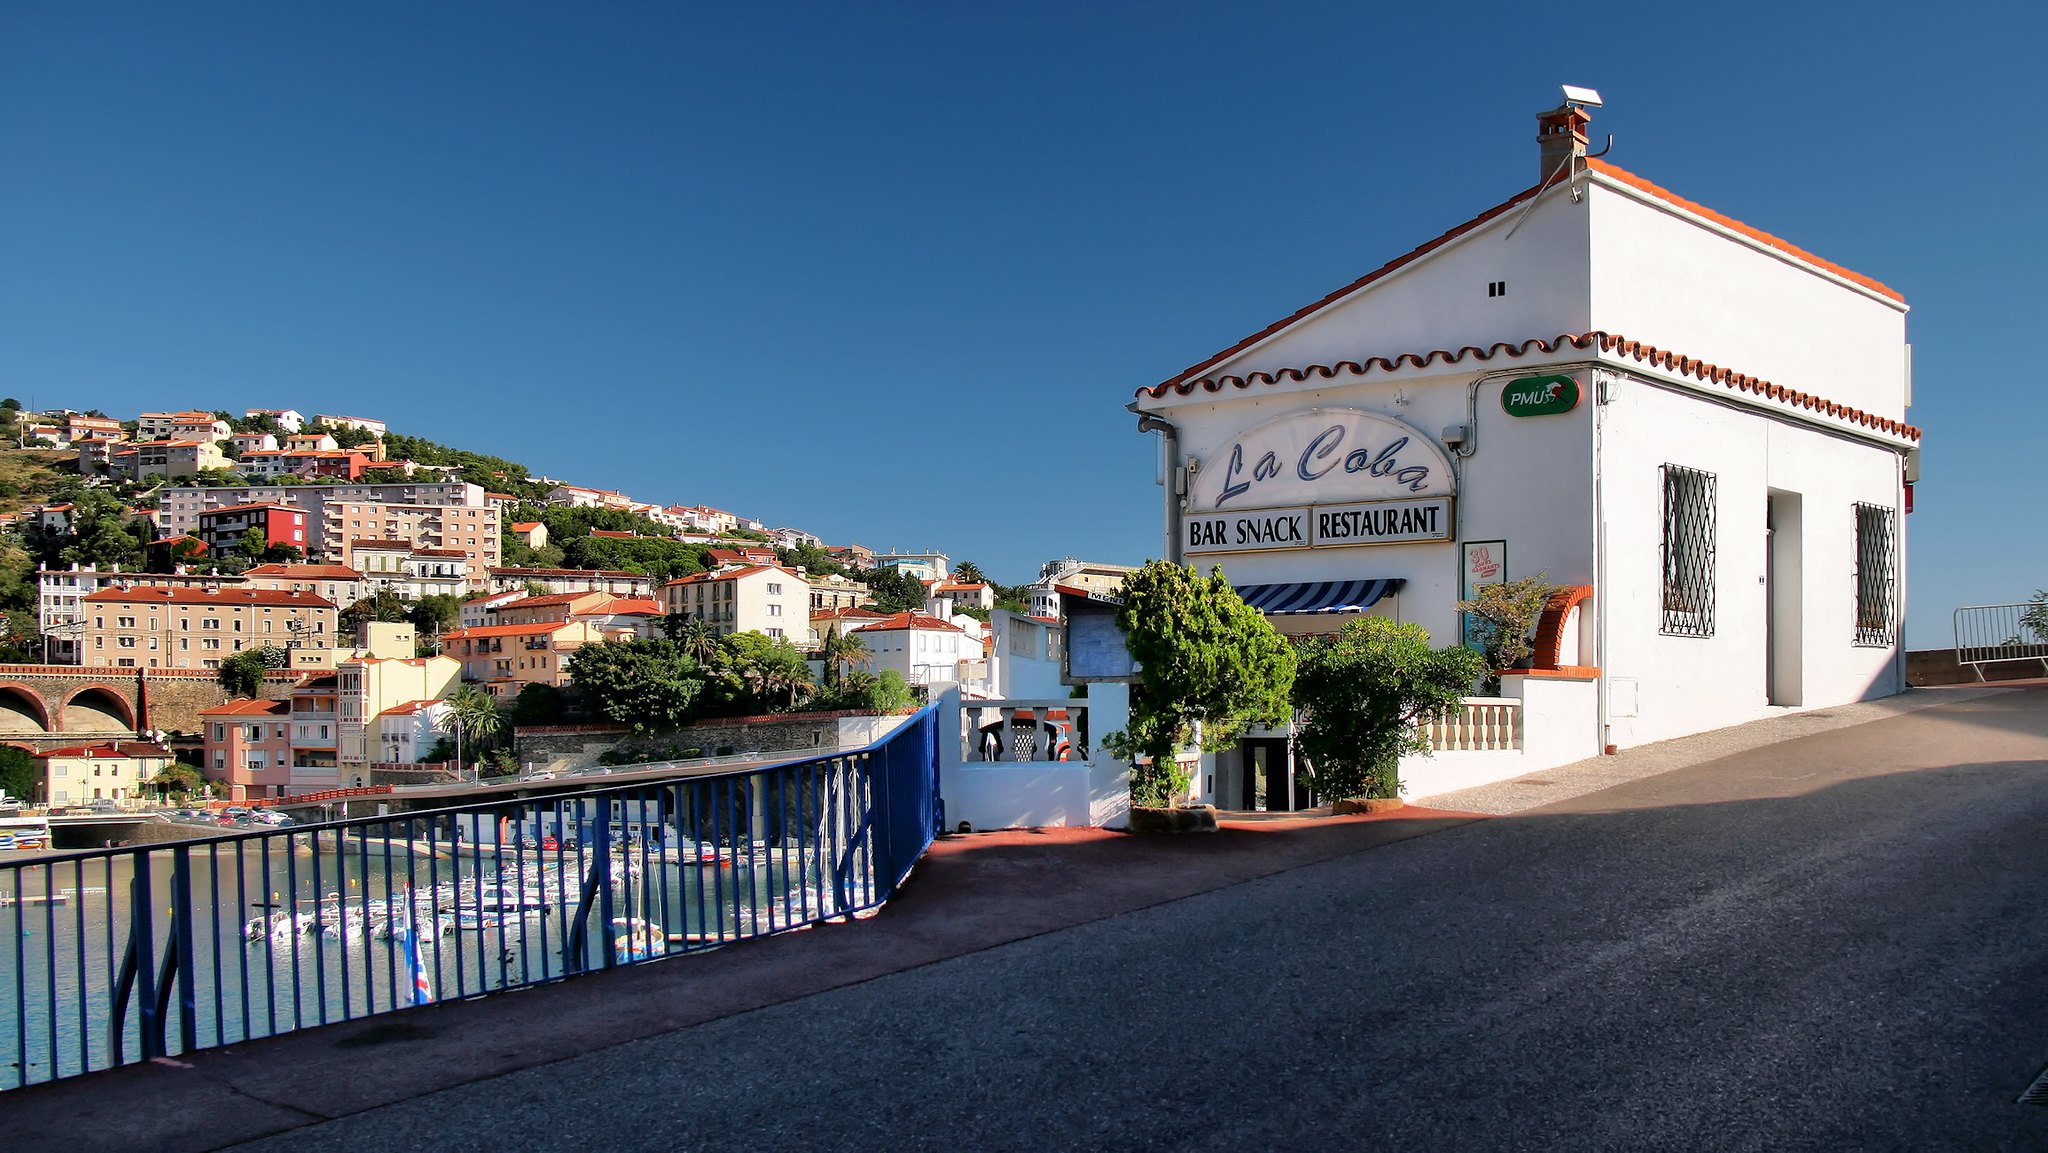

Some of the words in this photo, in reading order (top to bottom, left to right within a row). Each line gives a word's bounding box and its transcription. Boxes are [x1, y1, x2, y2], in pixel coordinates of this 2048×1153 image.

[1510, 390, 1545, 406] PMU
[1214, 443, 1283, 509] La
[1297, 424, 1430, 492] Coba
[1189, 519, 1228, 547] BAR
[1236, 515, 1302, 545] SNACK
[1319, 506, 1440, 539] RESTAURANT
